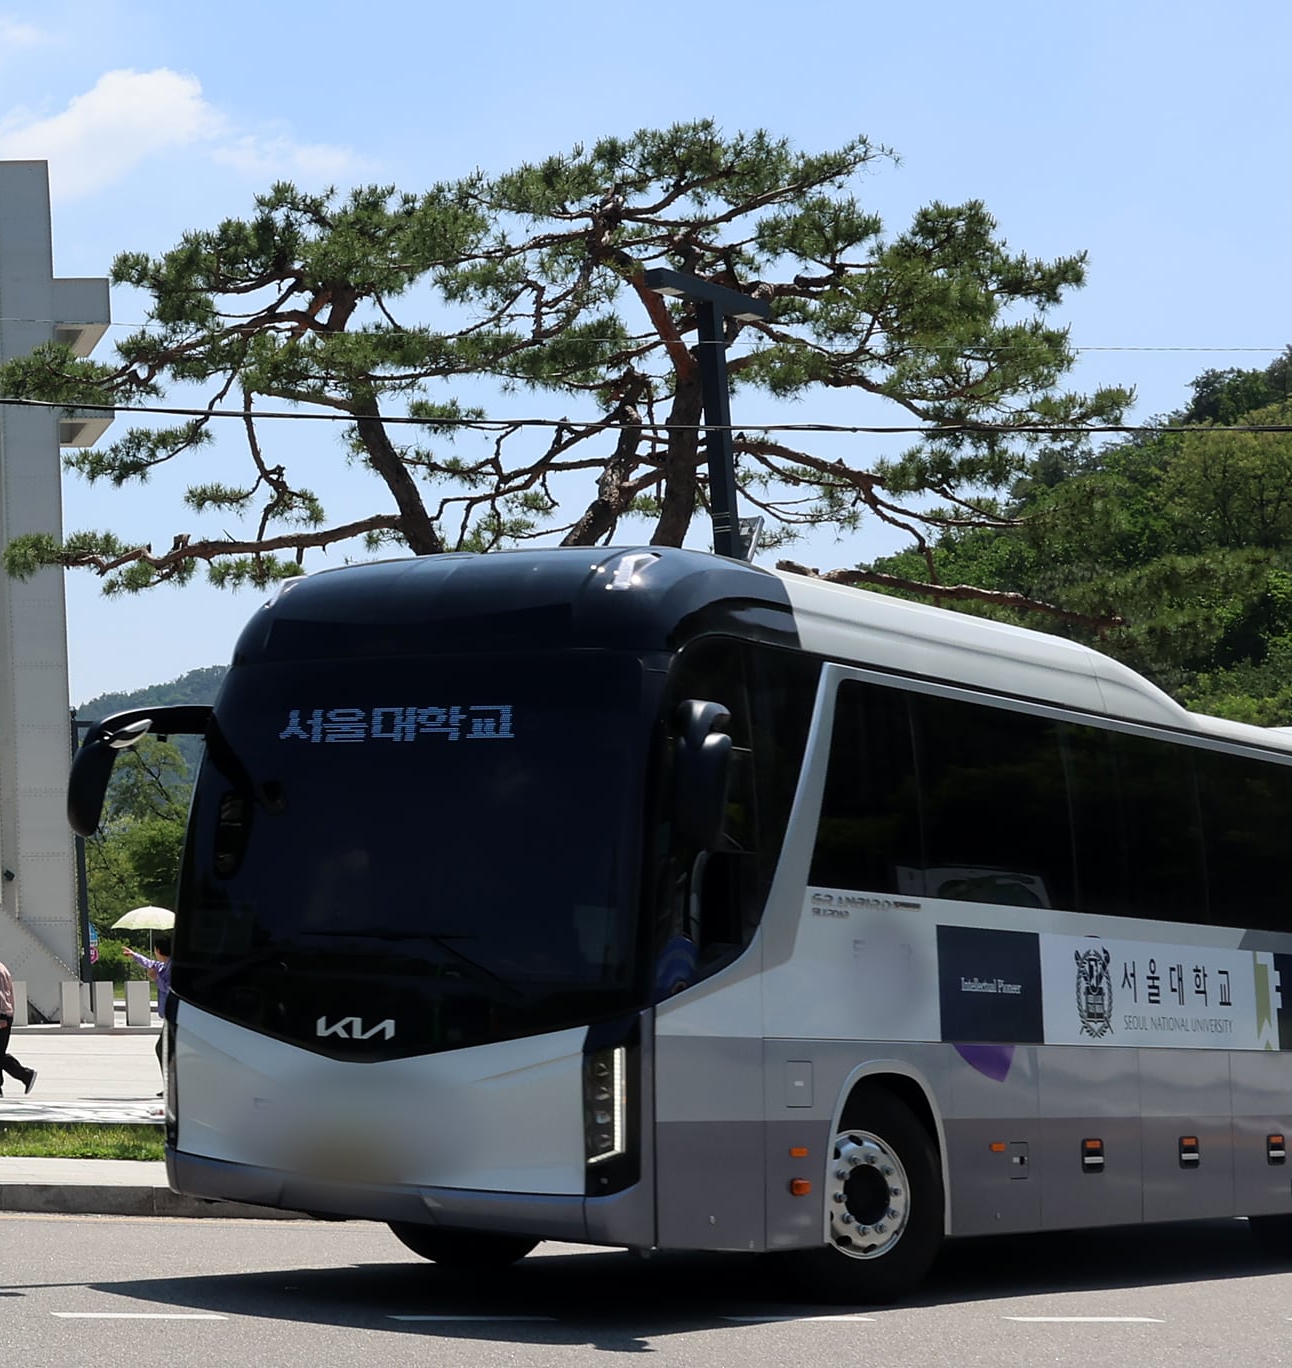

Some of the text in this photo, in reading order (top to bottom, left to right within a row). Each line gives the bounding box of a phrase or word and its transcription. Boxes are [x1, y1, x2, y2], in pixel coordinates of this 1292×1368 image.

[279, 704, 515, 743] 서울대학교
[1121, 957, 1233, 1007] 서울대학교
[315, 1016, 396, 1041] KIA
[1123, 1014, 1233, 1034] SEOUL NATIONAL UNIVERSITY
